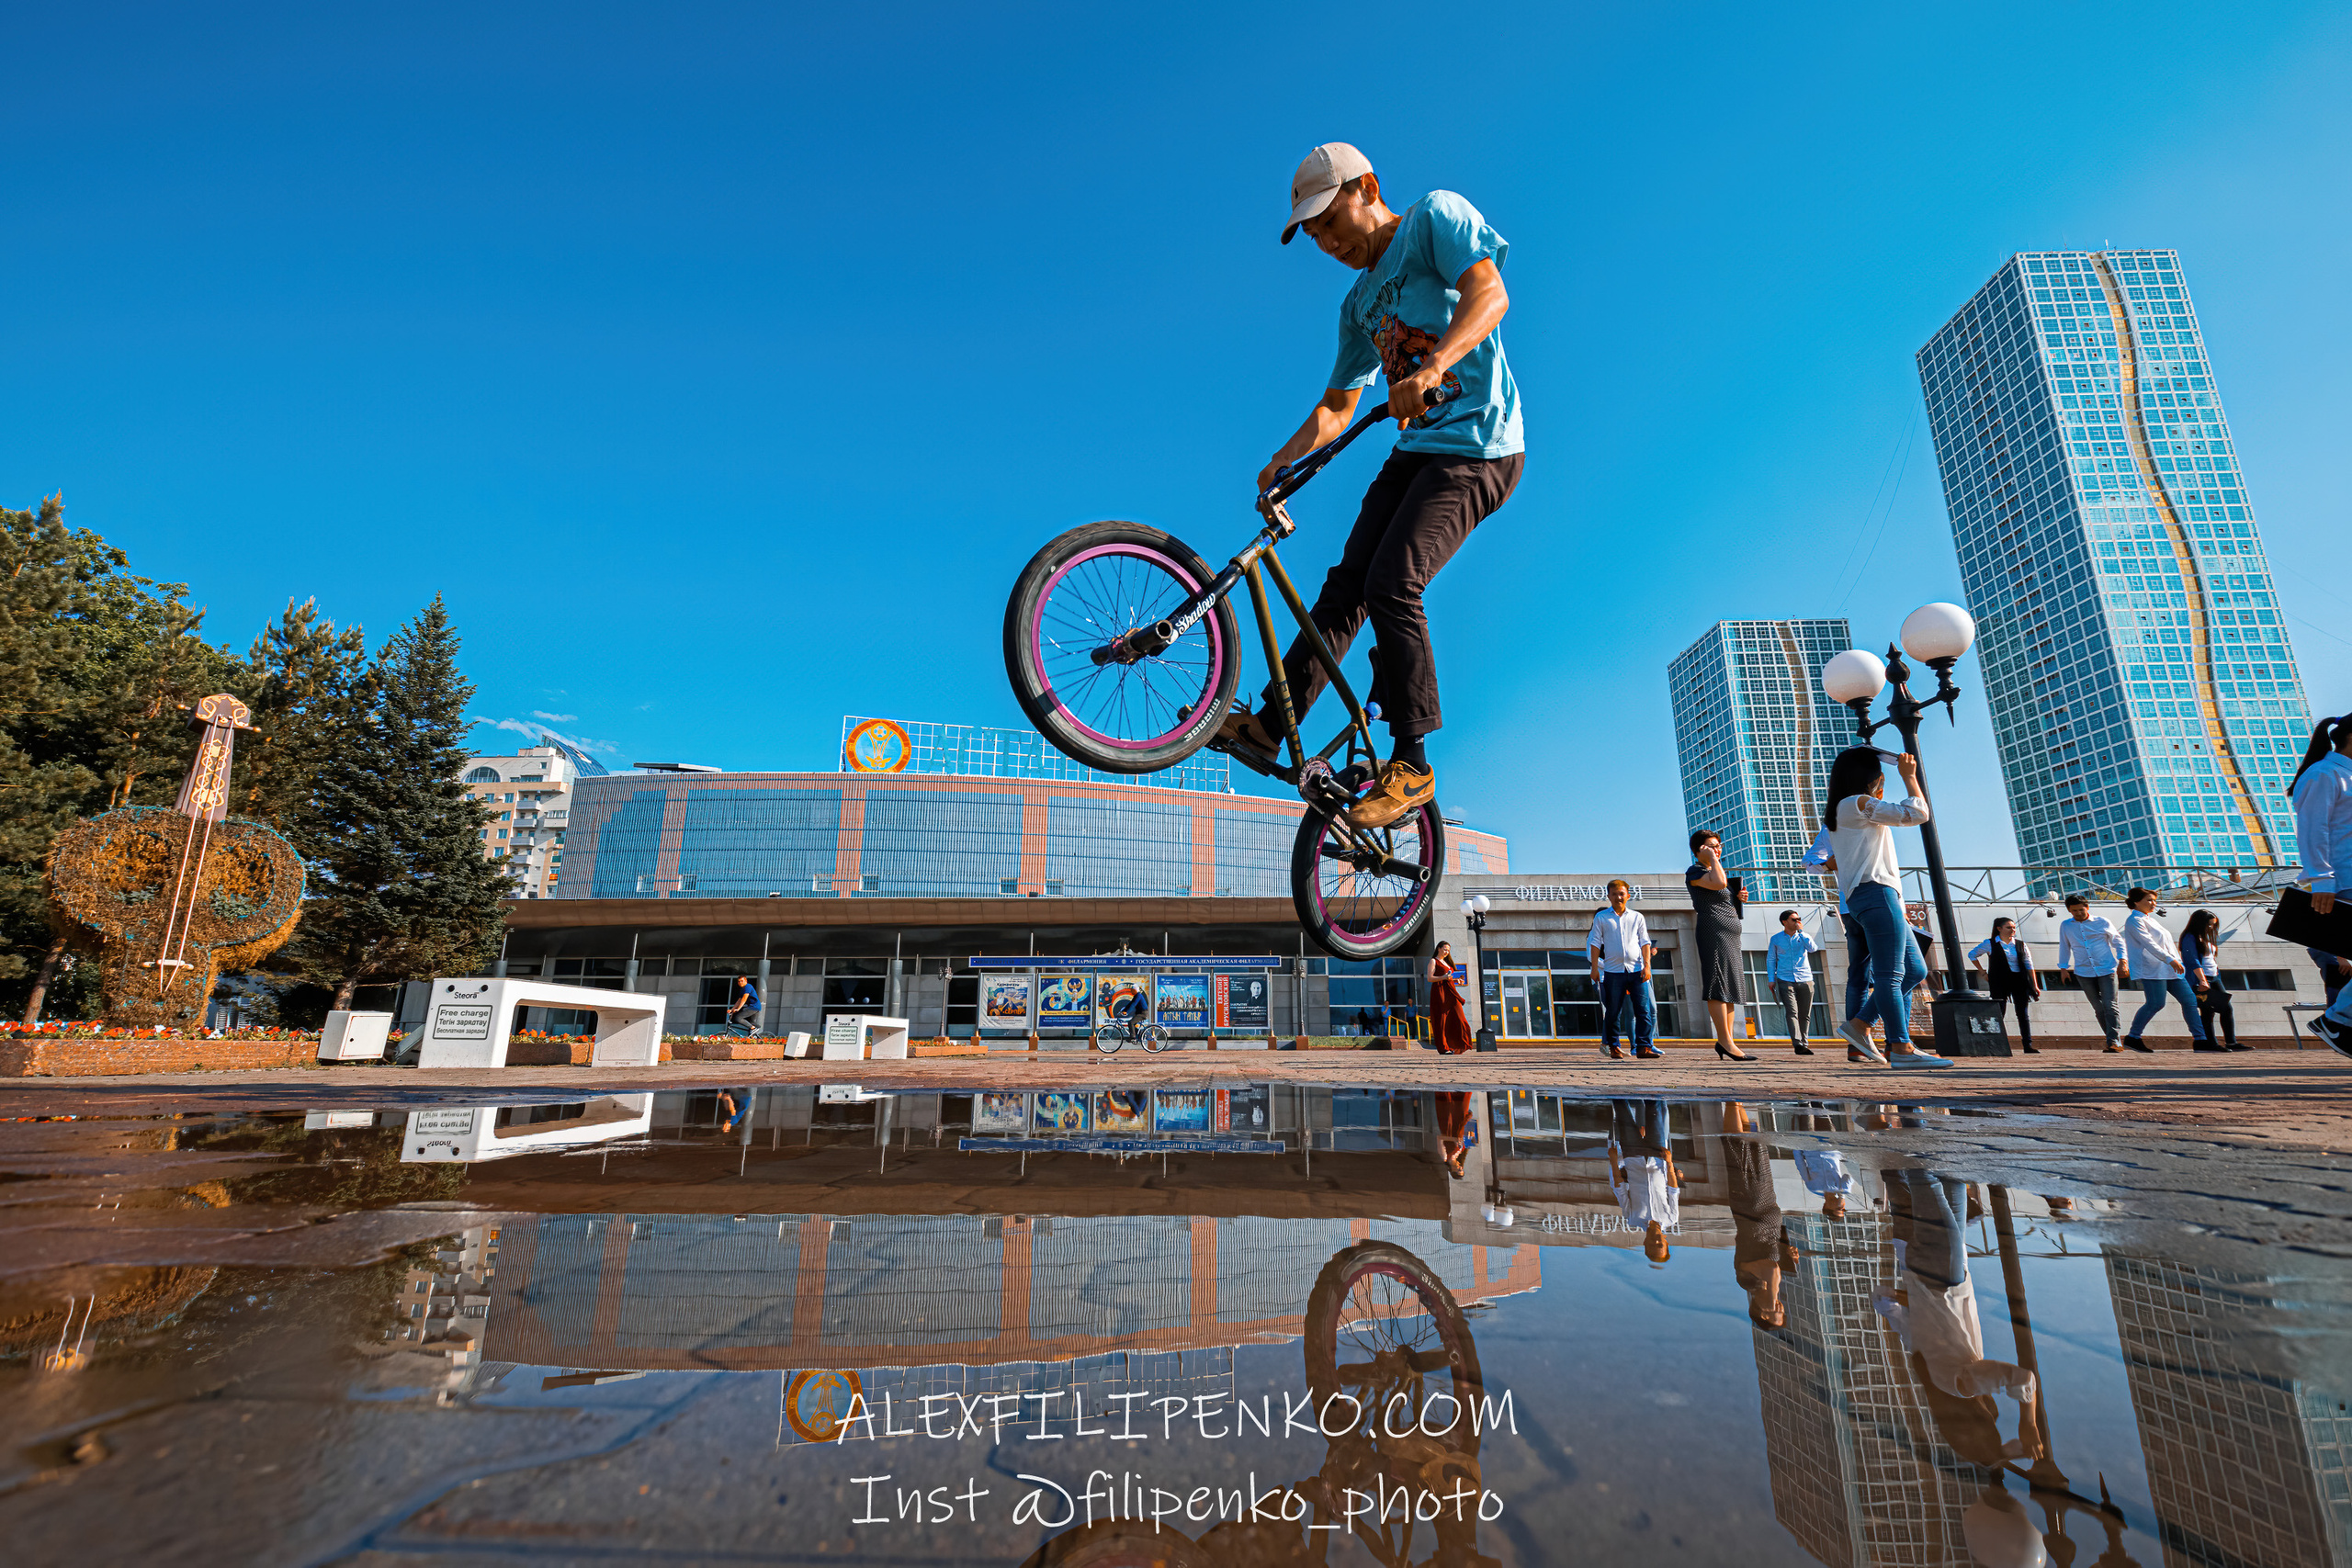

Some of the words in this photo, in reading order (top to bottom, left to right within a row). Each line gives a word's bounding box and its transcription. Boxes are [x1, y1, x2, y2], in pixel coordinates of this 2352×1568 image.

[1175, 592, 1216, 635] Shadow
[1515, 884, 1644, 901] ФИЛАРМОЯ
[1909, 910, 1927, 920] 30
[454, 991, 479, 999] Steora
[457, 1019, 488, 1027] зарядтау
